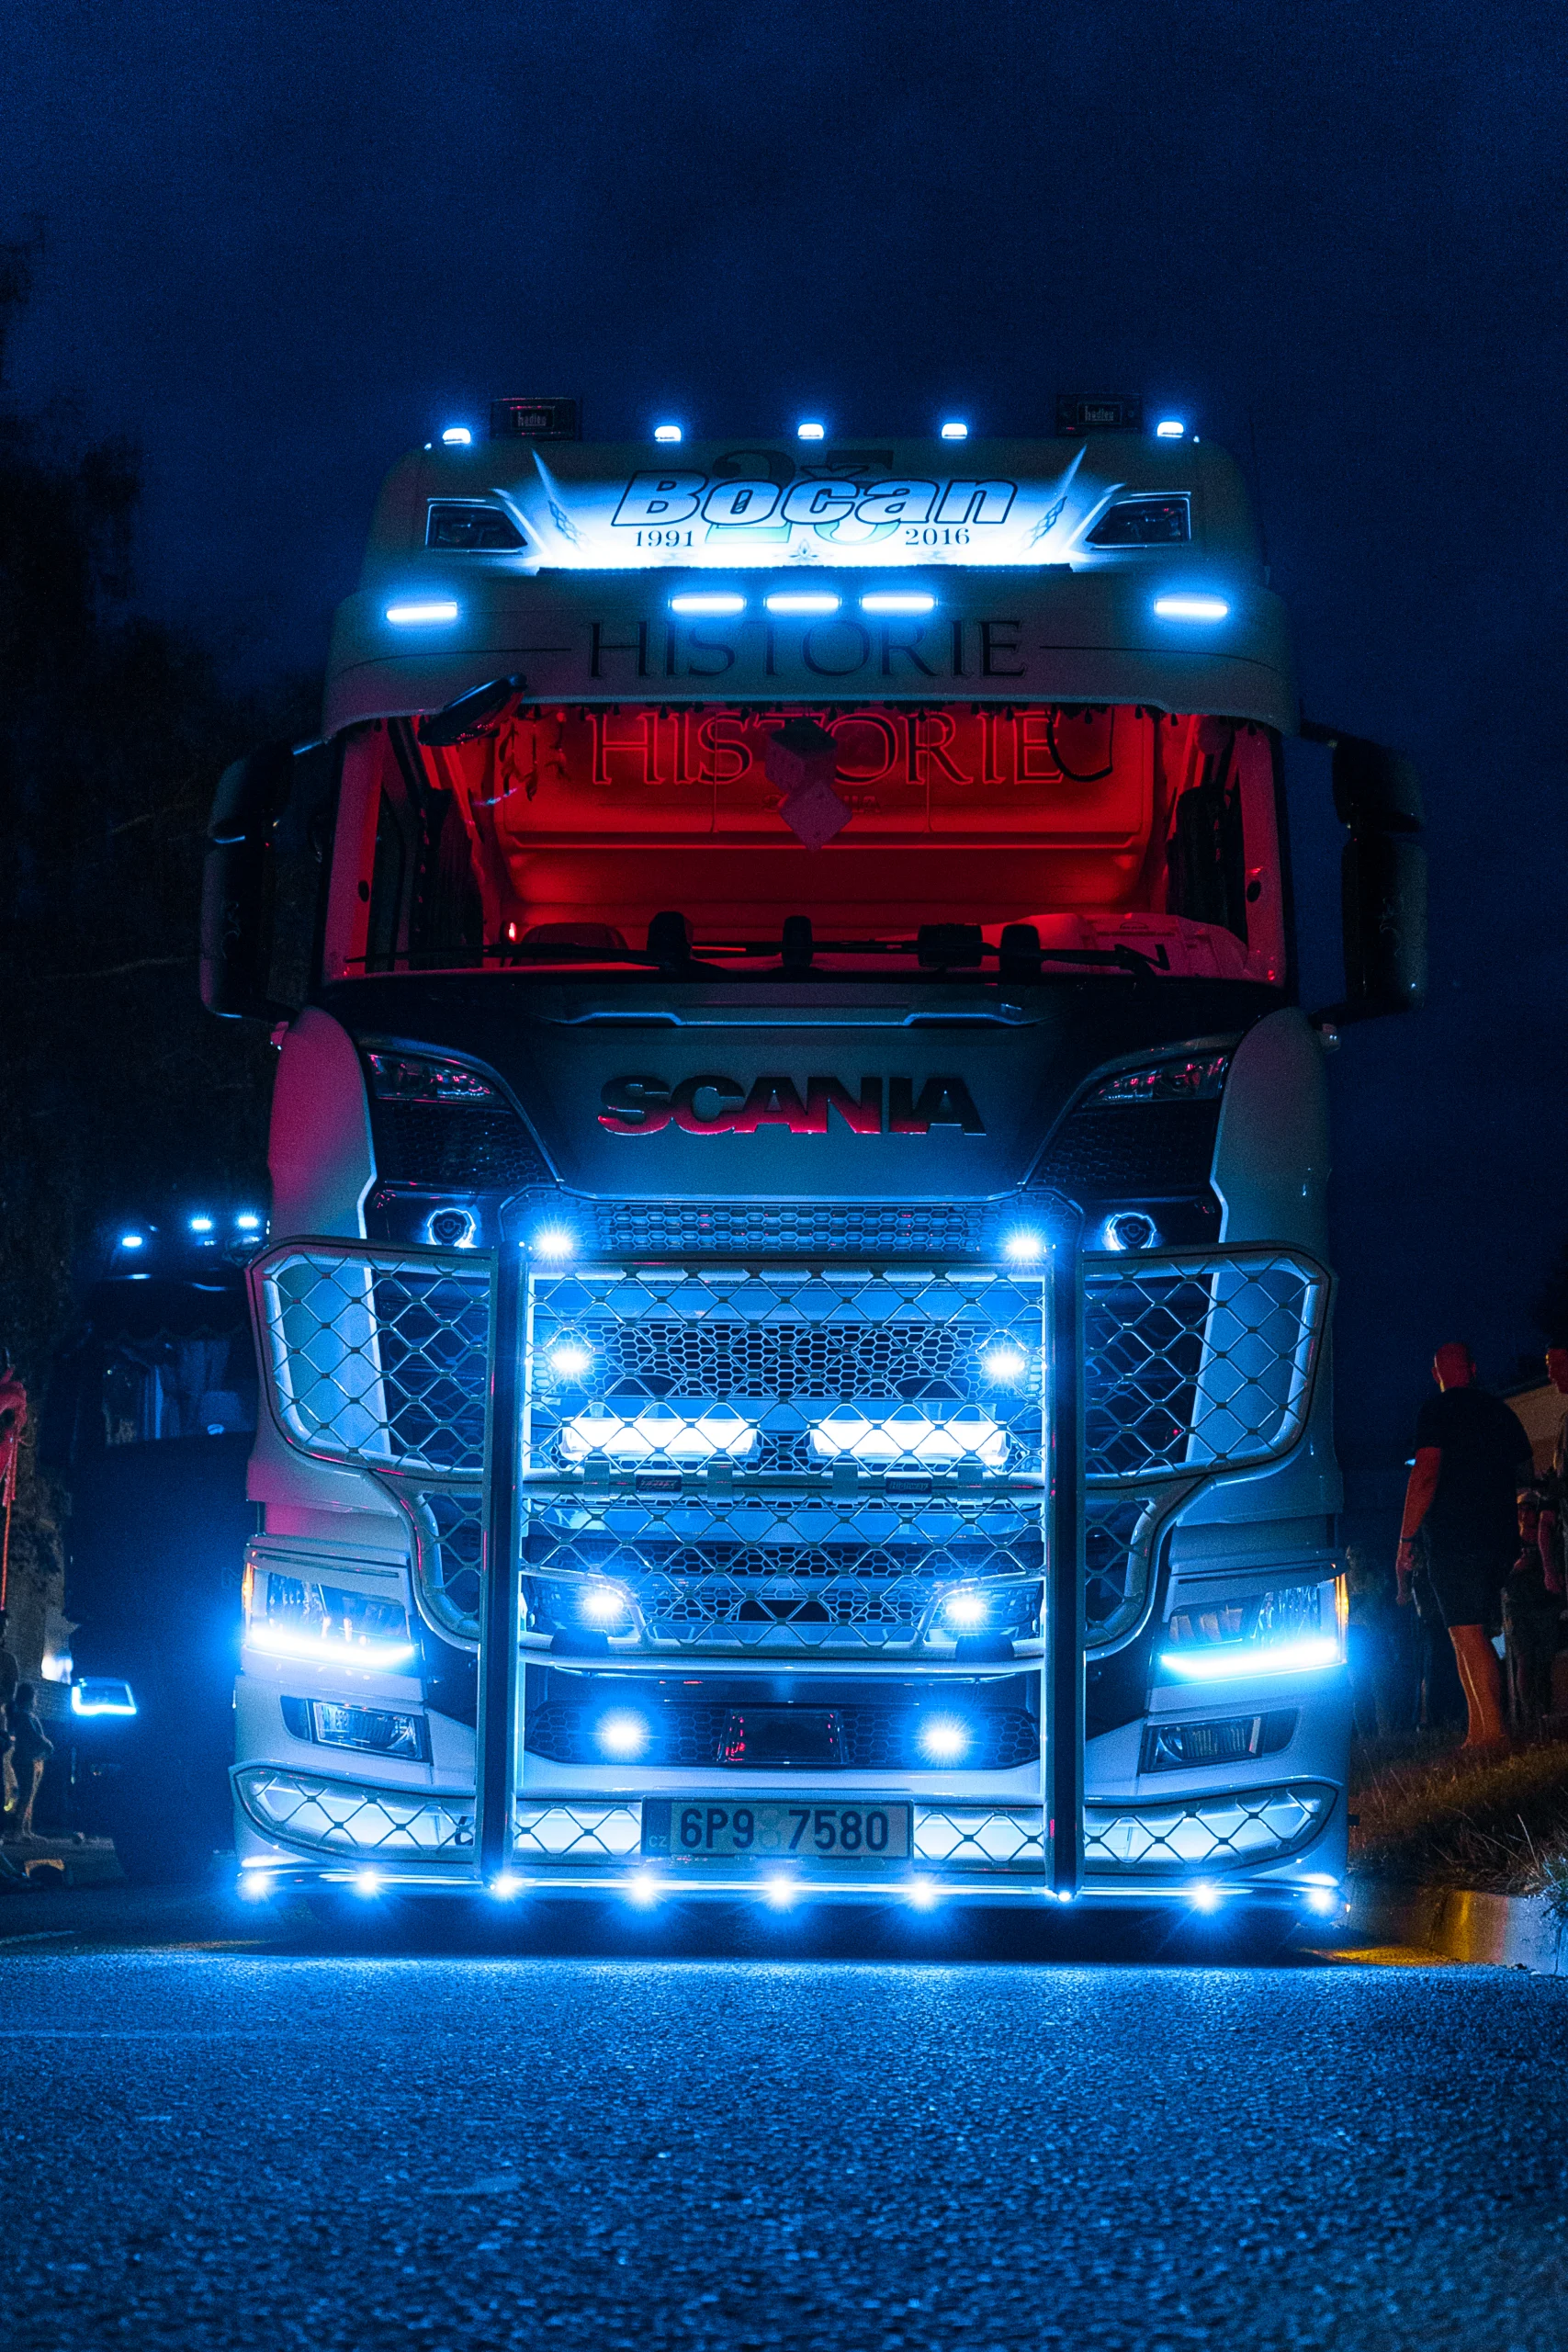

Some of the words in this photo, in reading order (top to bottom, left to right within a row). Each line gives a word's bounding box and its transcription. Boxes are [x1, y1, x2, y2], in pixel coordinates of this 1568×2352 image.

[611, 465, 1019, 526] Bočan
[634, 529, 695, 548] 1991
[904, 527, 971, 547] 2016
[586, 618, 1027, 678] HISTORIE
[596, 1074, 987, 1136] SCANIA
[649, 1836, 668, 1848] CZ
[680, 1807, 754, 1849] 6P9
[788, 1809, 889, 1851] 7580
